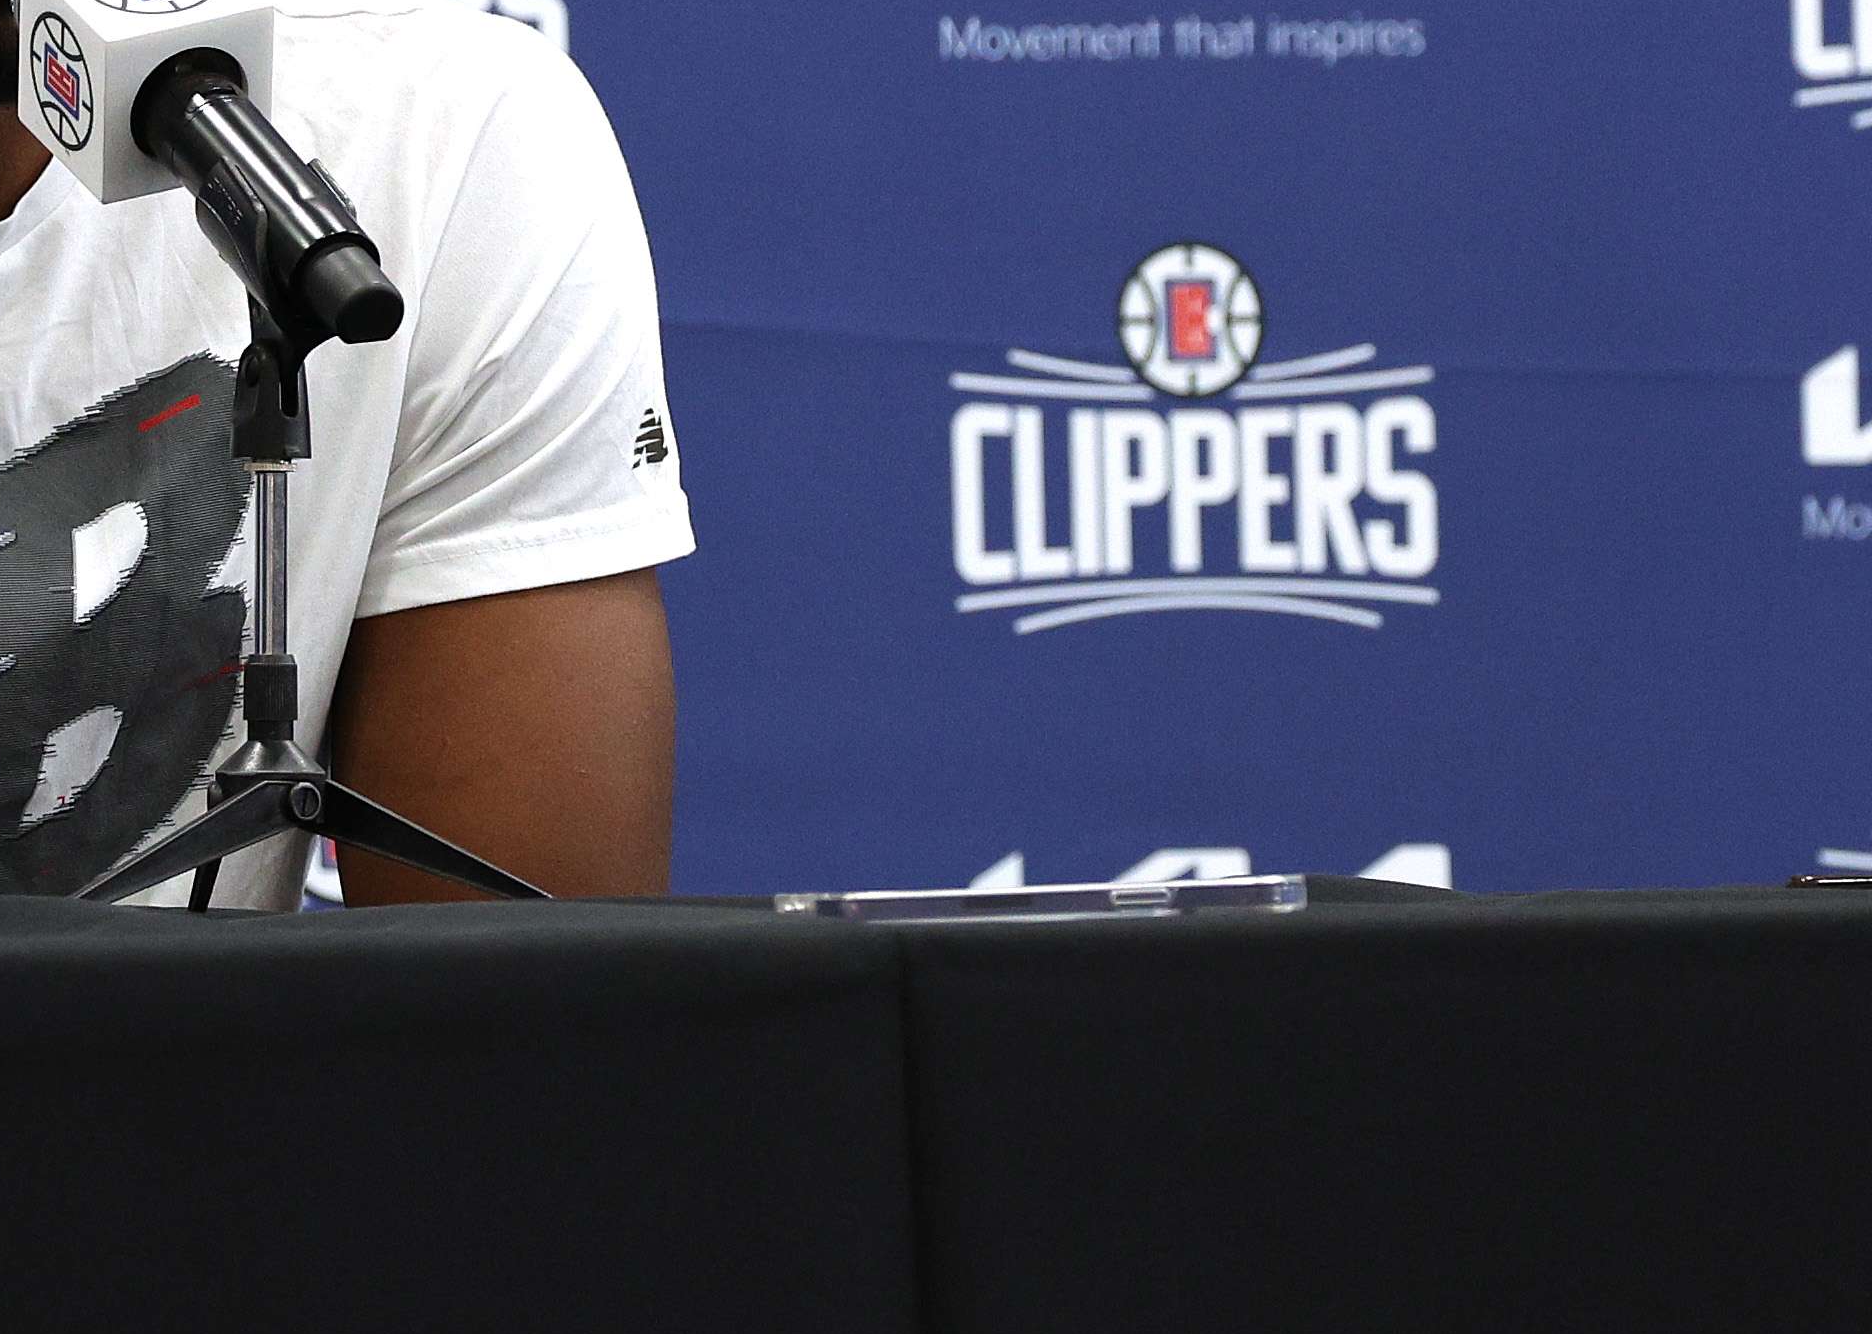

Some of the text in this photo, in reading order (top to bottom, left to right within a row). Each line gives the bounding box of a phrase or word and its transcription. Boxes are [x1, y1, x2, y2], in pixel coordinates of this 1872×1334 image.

[939, 13, 1425, 65] Movement that inspires
[951, 397, 1438, 584] CLIPPERS
